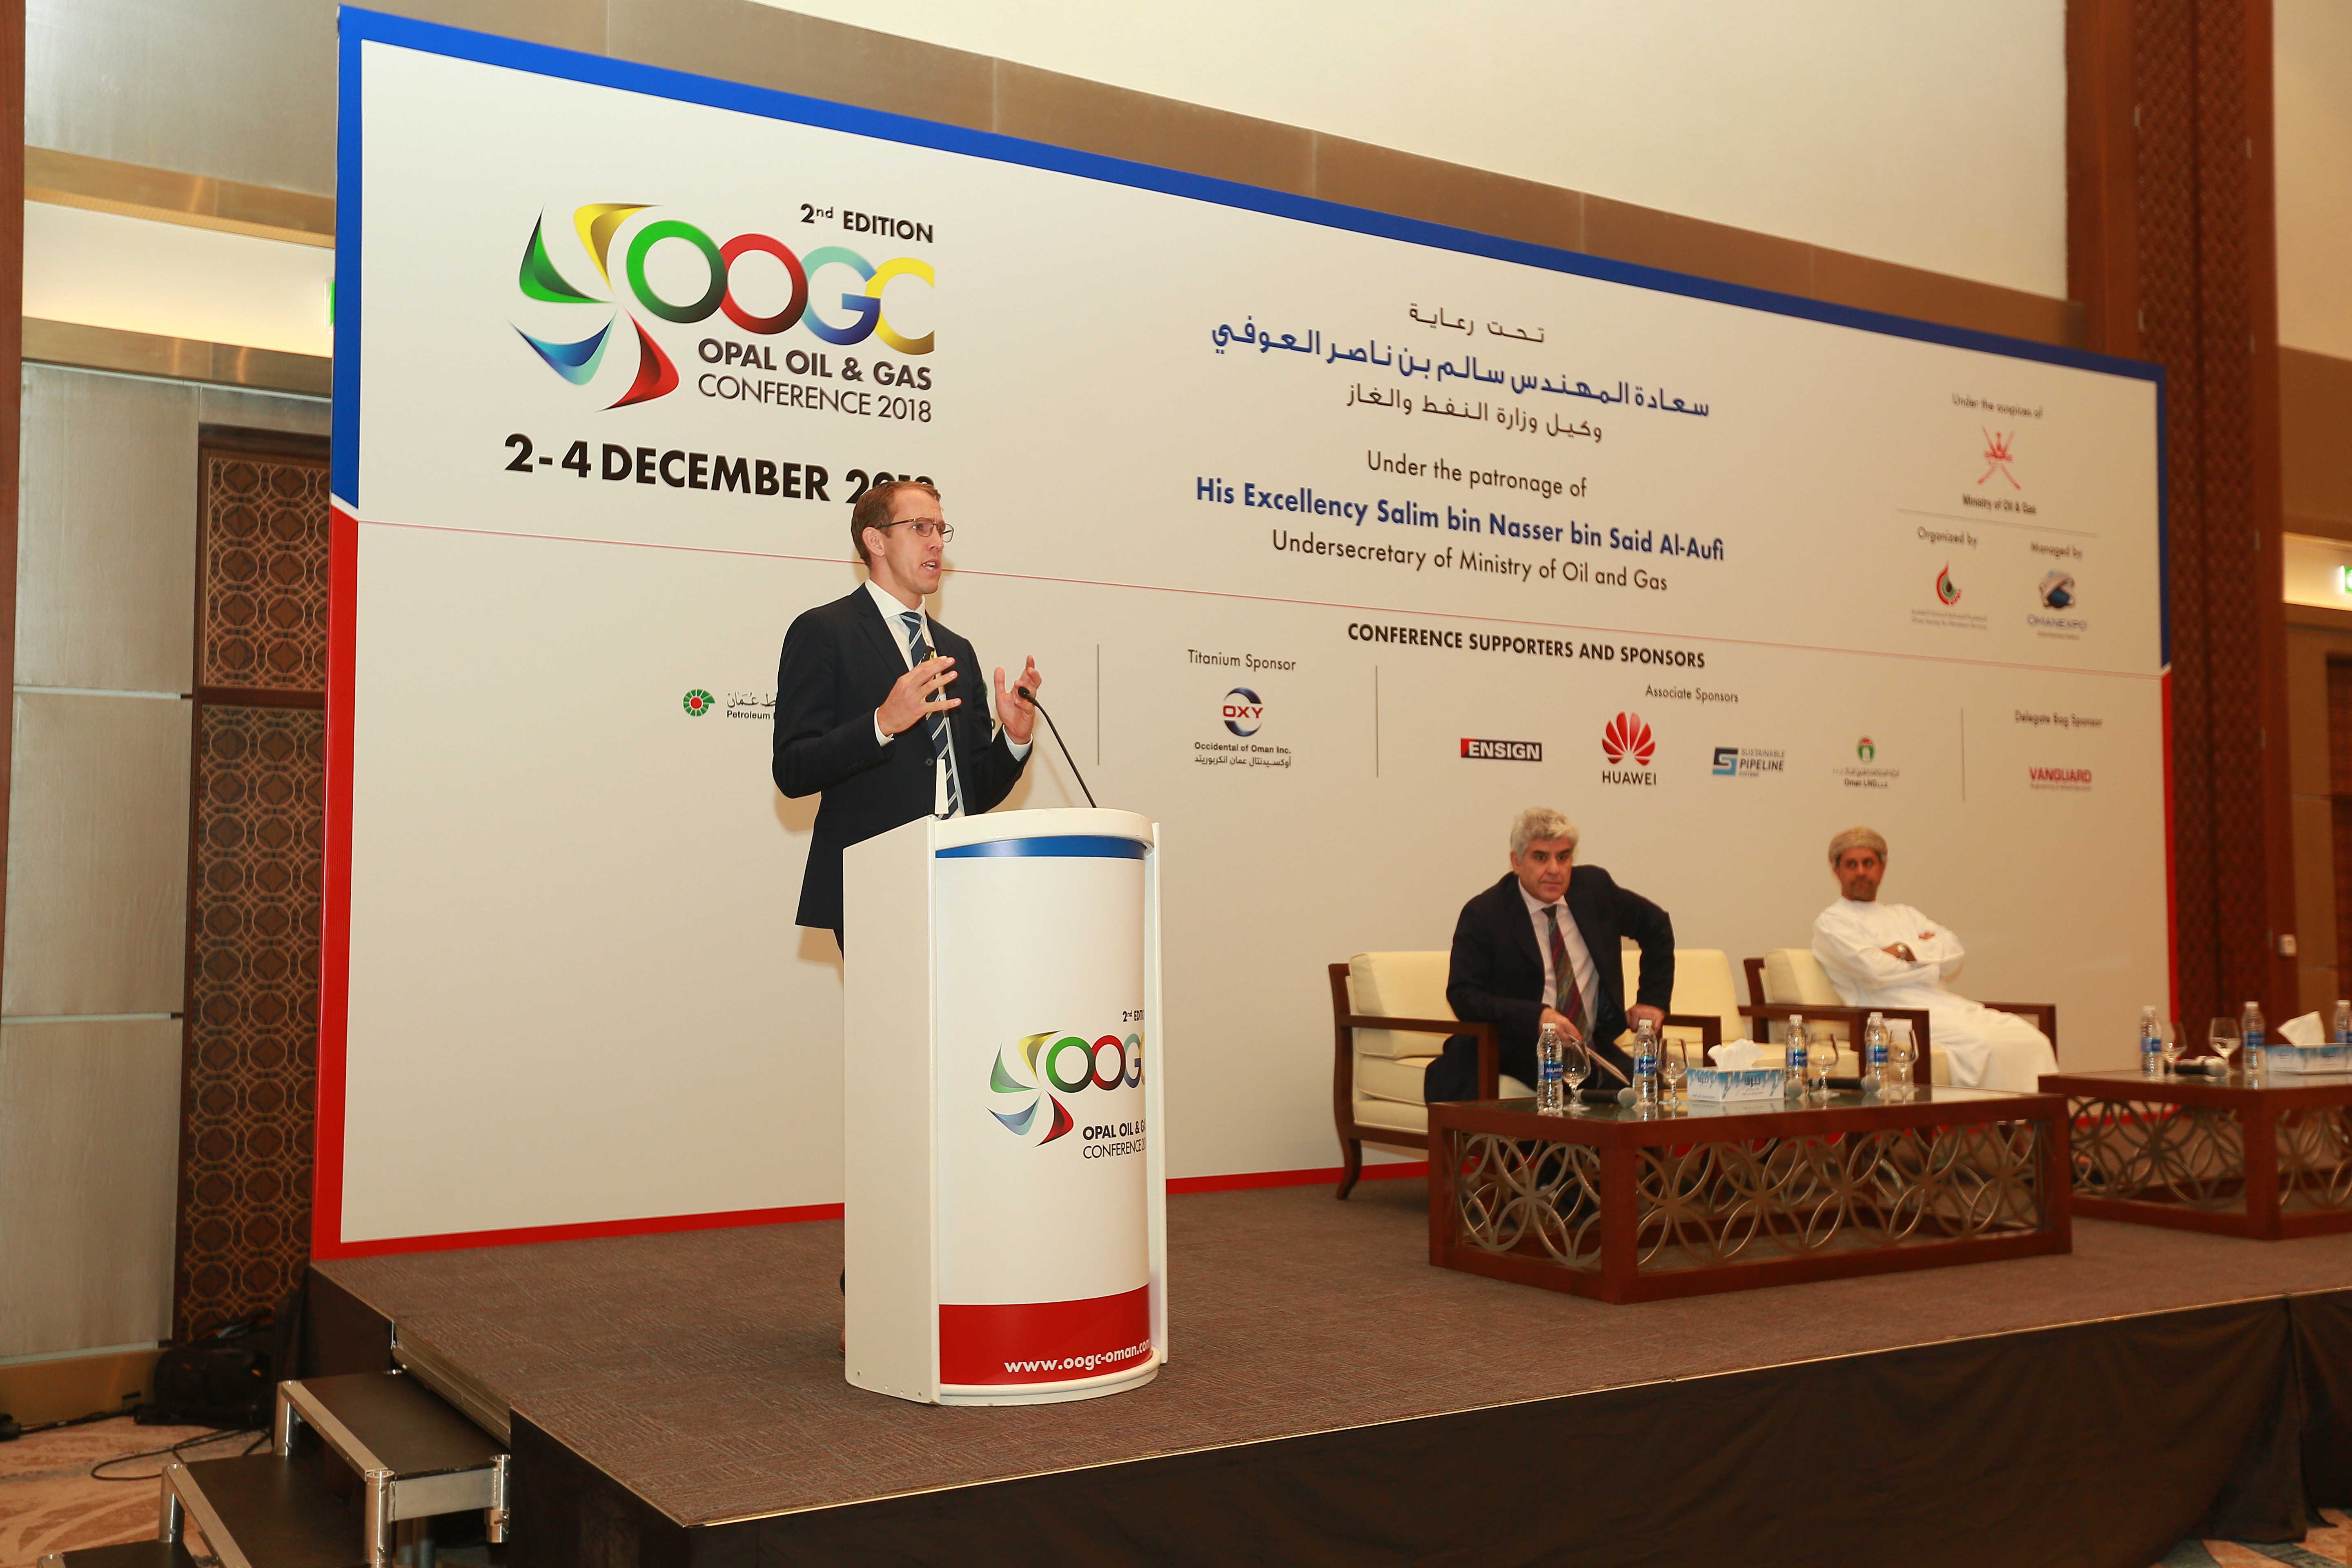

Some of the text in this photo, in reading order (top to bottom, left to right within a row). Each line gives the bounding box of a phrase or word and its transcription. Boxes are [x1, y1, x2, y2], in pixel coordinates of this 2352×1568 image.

[799, 202, 934, 243] 2nd EDITION
[626, 219, 935, 355] OOGC
[1487, 320, 1544, 343] تحت
[698, 338, 932, 391] OPAL OIL & GAS
[1212, 314, 1709, 417] سعادة المهندس سالم بن ناصر العوفي
[698, 372, 932, 423] CONFERENCE 2018
[1346, 382, 1603, 443] وكيل وزارة النفط والغاز
[601, 442, 831, 501] DECEMBER
[1368, 449, 1587, 499] Under the patronage of
[1962, 493, 1992, 512] Ministry
[1197, 476, 1724, 561] His Excellency Salim bin Nasser bin Said Al-Aufi
[1918, 526, 1978, 550] Organized by
[1273, 528, 1667, 591] Undersecretary of Ministry of Oil and Gas
[2031, 540, 2070, 560] Managed
[1348, 623, 1705, 668] CONFERENCE SUPPORTERS AND SPONSORS
[1188, 649, 1296, 672] Titanium Sponsor
[1646, 684, 1739, 704] Associate Sponsors
[727, 710, 771, 719] Petroleum
[1223, 704, 1264, 719] OXY
[1195, 742, 1292, 754] Occidental of Oman Inc.
[1468, 741, 1541, 760] ENSIGN
[1741, 748, 1785, 757] SUSTAINABLE
[1230, 755, 1246, 765] عمان
[1740, 758, 1784, 771] PIPELINE
[1602, 771, 1657, 786] HUAWEI
[2030, 766, 2092, 783] VANGUARD
[1123, 1010, 1132, 1022] 2nd
[1083, 1124, 1117, 1140] OPAL
[1119, 1122, 1134, 1137] OIL
[1135, 1120, 1140, 1134] &
[1083, 1138, 1141, 1159] CONFERENCE
